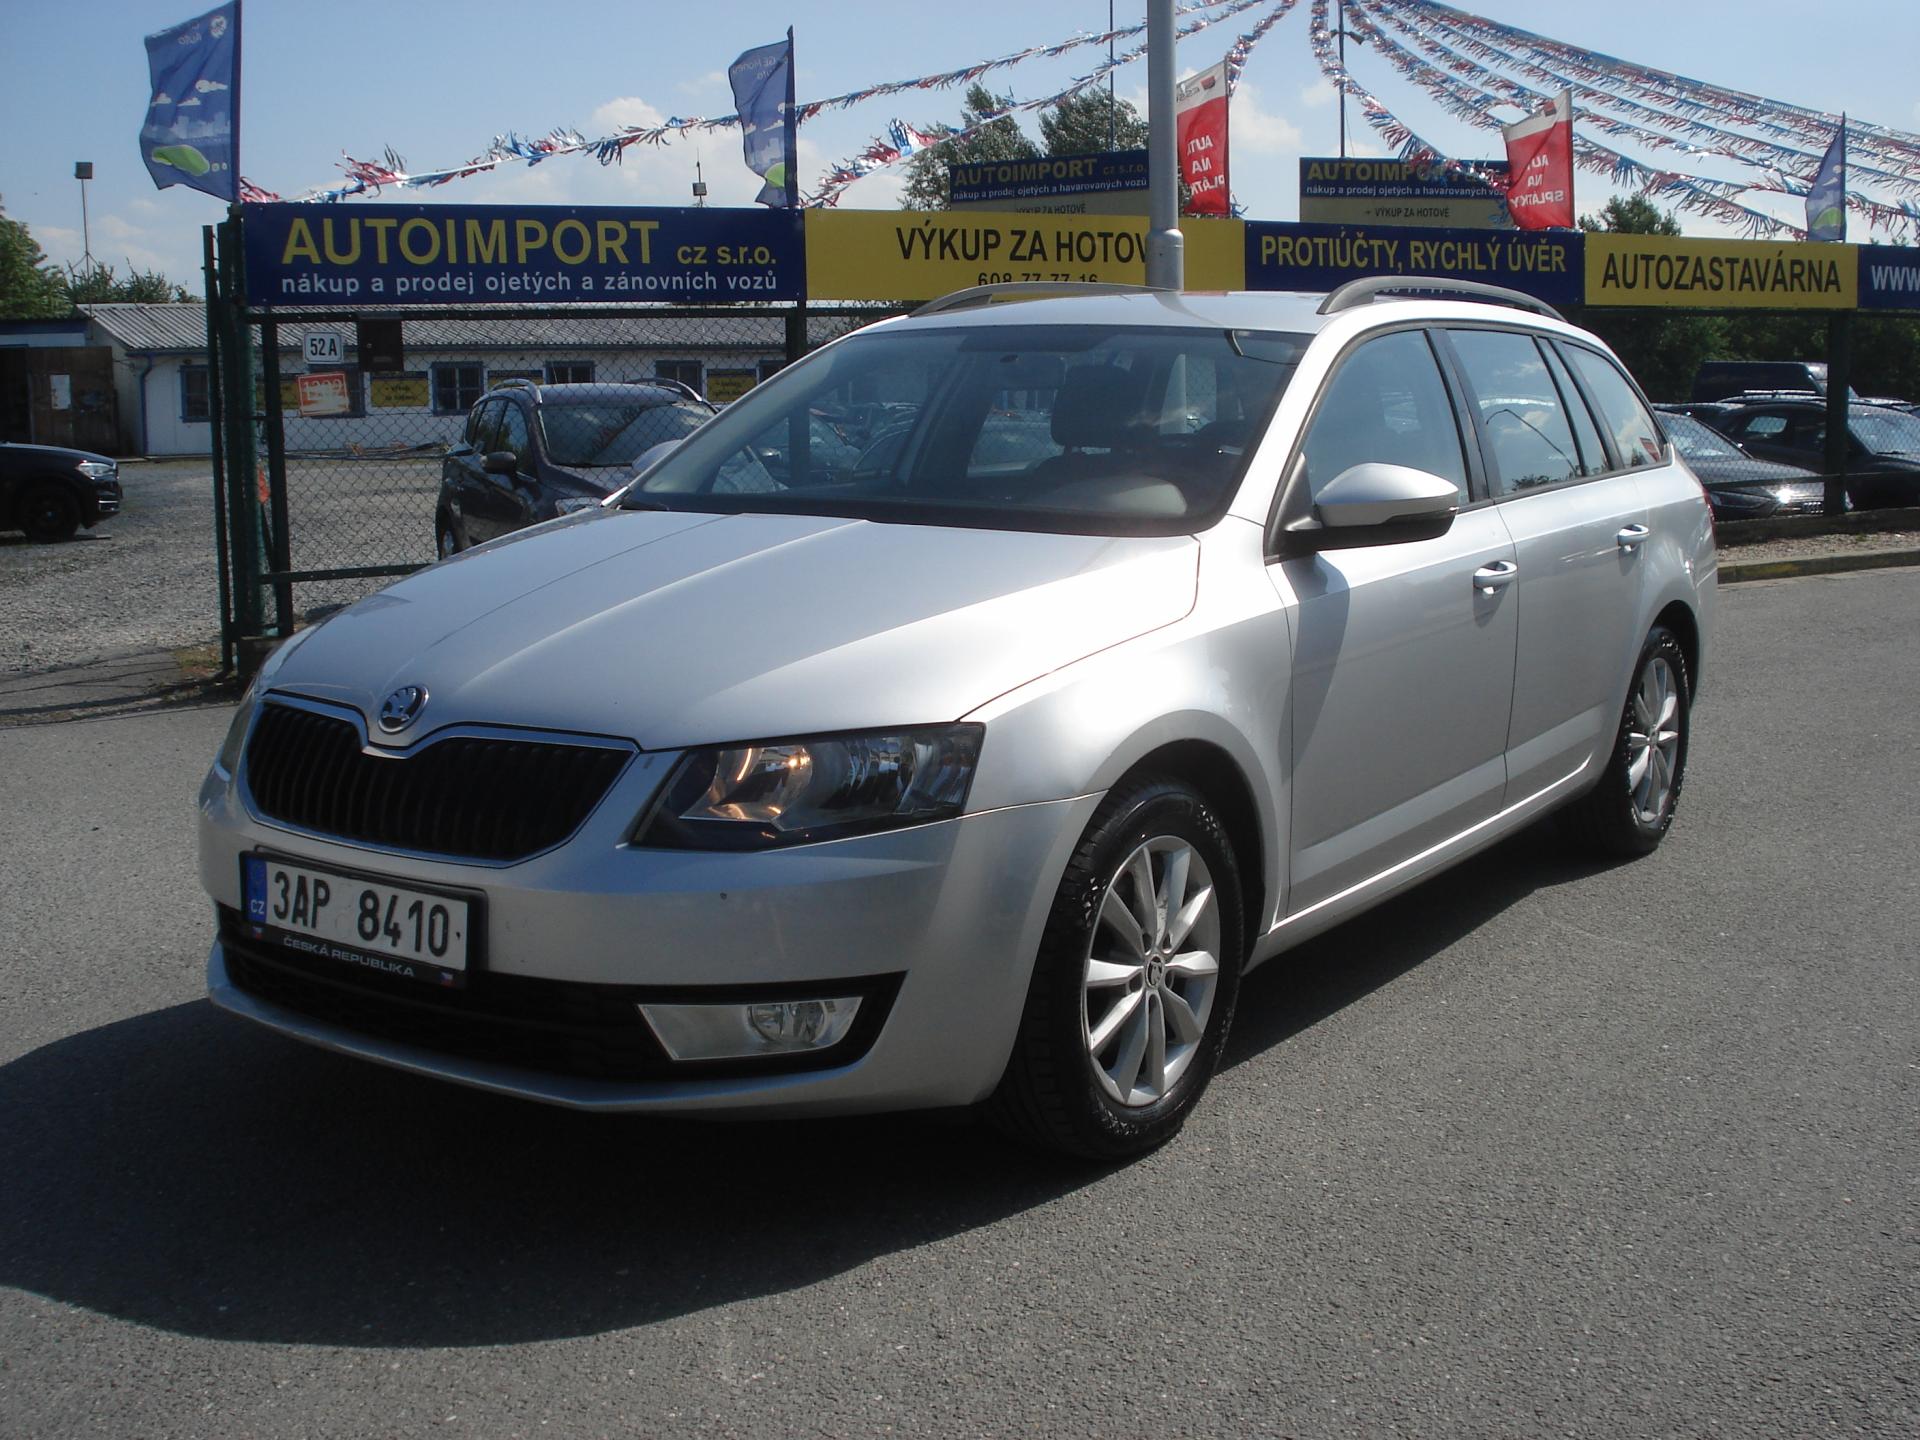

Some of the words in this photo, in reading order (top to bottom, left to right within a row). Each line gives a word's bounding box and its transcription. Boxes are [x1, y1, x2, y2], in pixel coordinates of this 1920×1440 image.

[954, 158, 1098, 187] AUTOIMPORT
[953, 190, 980, 201] nákup
[989, 188, 1016, 199] prodej
[1018, 185, 1050, 197] ojetých
[1059, 180, 1122, 193] havarovaných
[1125, 177, 1147, 187] vozů
[1306, 185, 1336, 195] nákup
[1346, 185, 1377, 196] prodej
[1378, 185, 1411, 196] ojetých
[1415, 187, 1421, 195] a
[1375, 206, 1402, 218] VÝKUP
[1404, 207, 1415, 218] ZA
[281, 217, 660, 265] AUTOIMPORT
[676, 245, 708, 265] cz
[717, 245, 777, 265] s.r.o.
[896, 219, 1001, 262] VÝKUP
[1009, 229, 1048, 263] ZA
[1261, 231, 1404, 273] PROTIÚČTY,
[1410, 235, 1501, 271] RYCHLÝ
[1508, 237, 1566, 272] ÚVĚR
[281, 272, 360, 296] nákup
[370, 276, 385, 292] a
[395, 271, 474, 295] prodej
[485, 271, 571, 295] ojetých
[581, 275, 594, 290] a
[604, 271, 717, 290] zánovních
[727, 269, 777, 290] vozů
[1601, 250, 1842, 293] AUTOZASTAVÁRNA
[310, 338, 326, 356] 52
[328, 338, 338, 356] A
[250, 898, 265, 915] CZ
[273, 871, 331, 930] 3AP
[357, 889, 449, 957] 8410
[283, 934, 330, 958] ČESKÁ
[331, 950, 415, 977] REPUBLIKA
